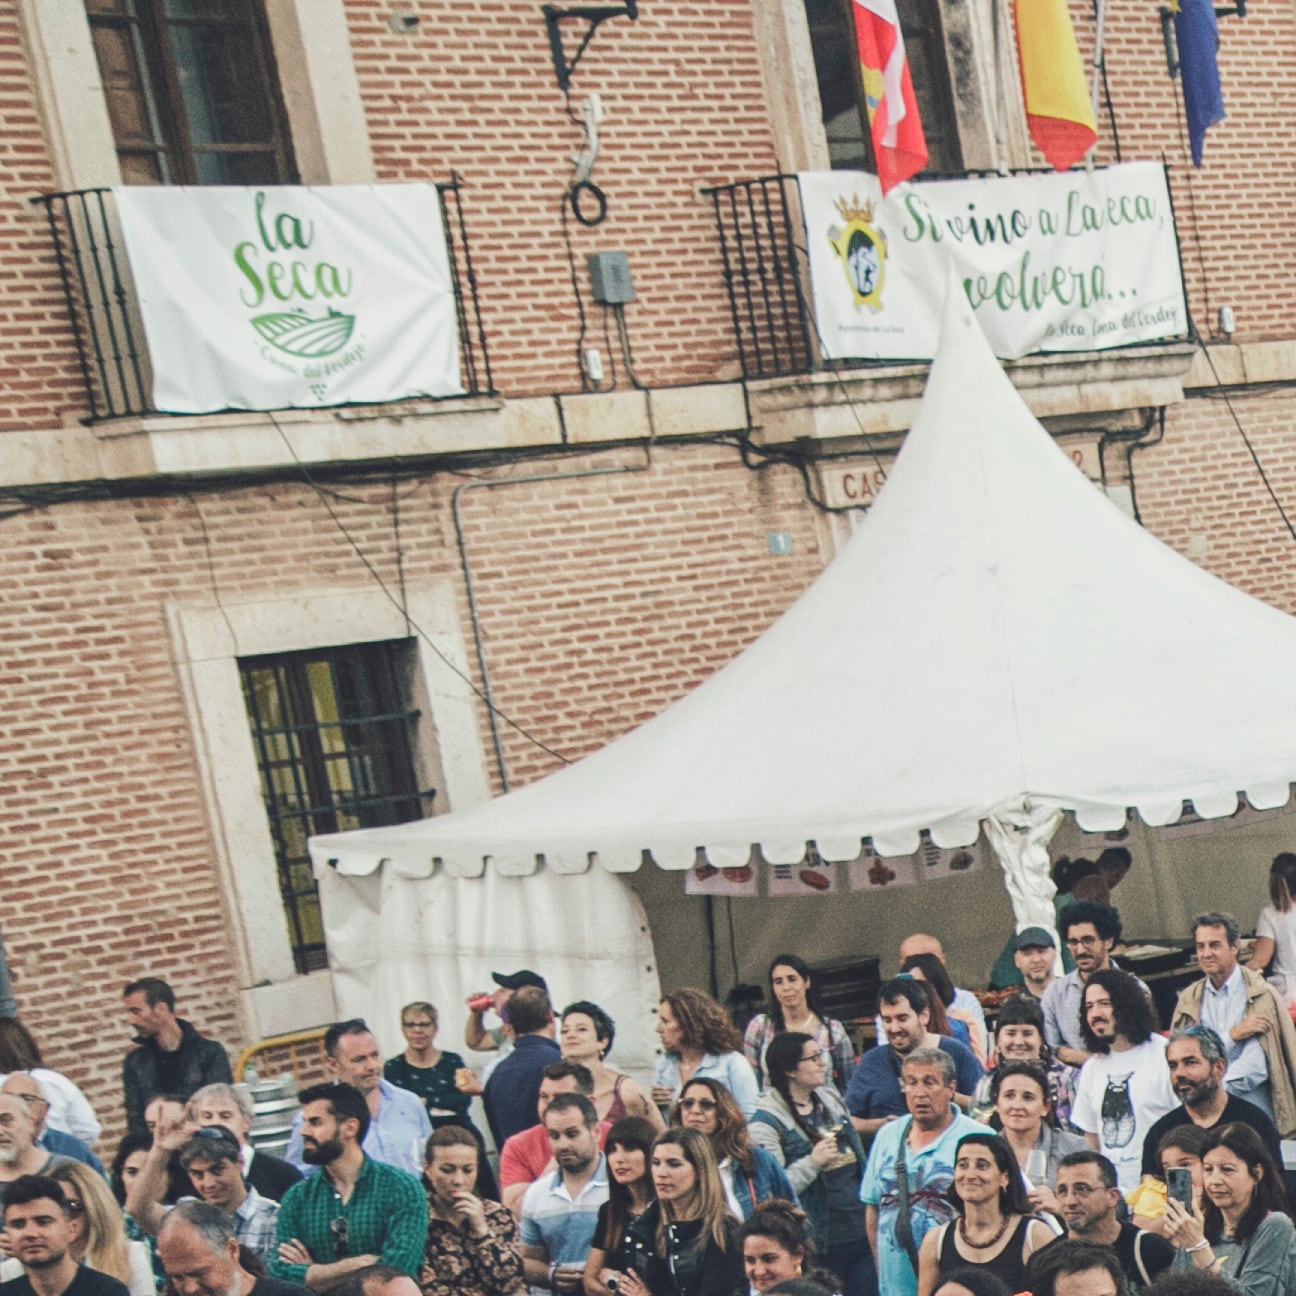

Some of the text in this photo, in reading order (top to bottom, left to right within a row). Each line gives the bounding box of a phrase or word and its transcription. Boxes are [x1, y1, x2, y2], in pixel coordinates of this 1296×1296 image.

[255, 191, 314, 252] la
[903, 193, 942, 243] Si
[946, 203, 1032, 245] vino
[1039, 208, 1058, 236] a
[1107, 194, 1164, 230] eca,
[233, 241, 353, 308] Seca
[843, 470, 887, 500] CAS
[776, 534, 785, 549] 1
